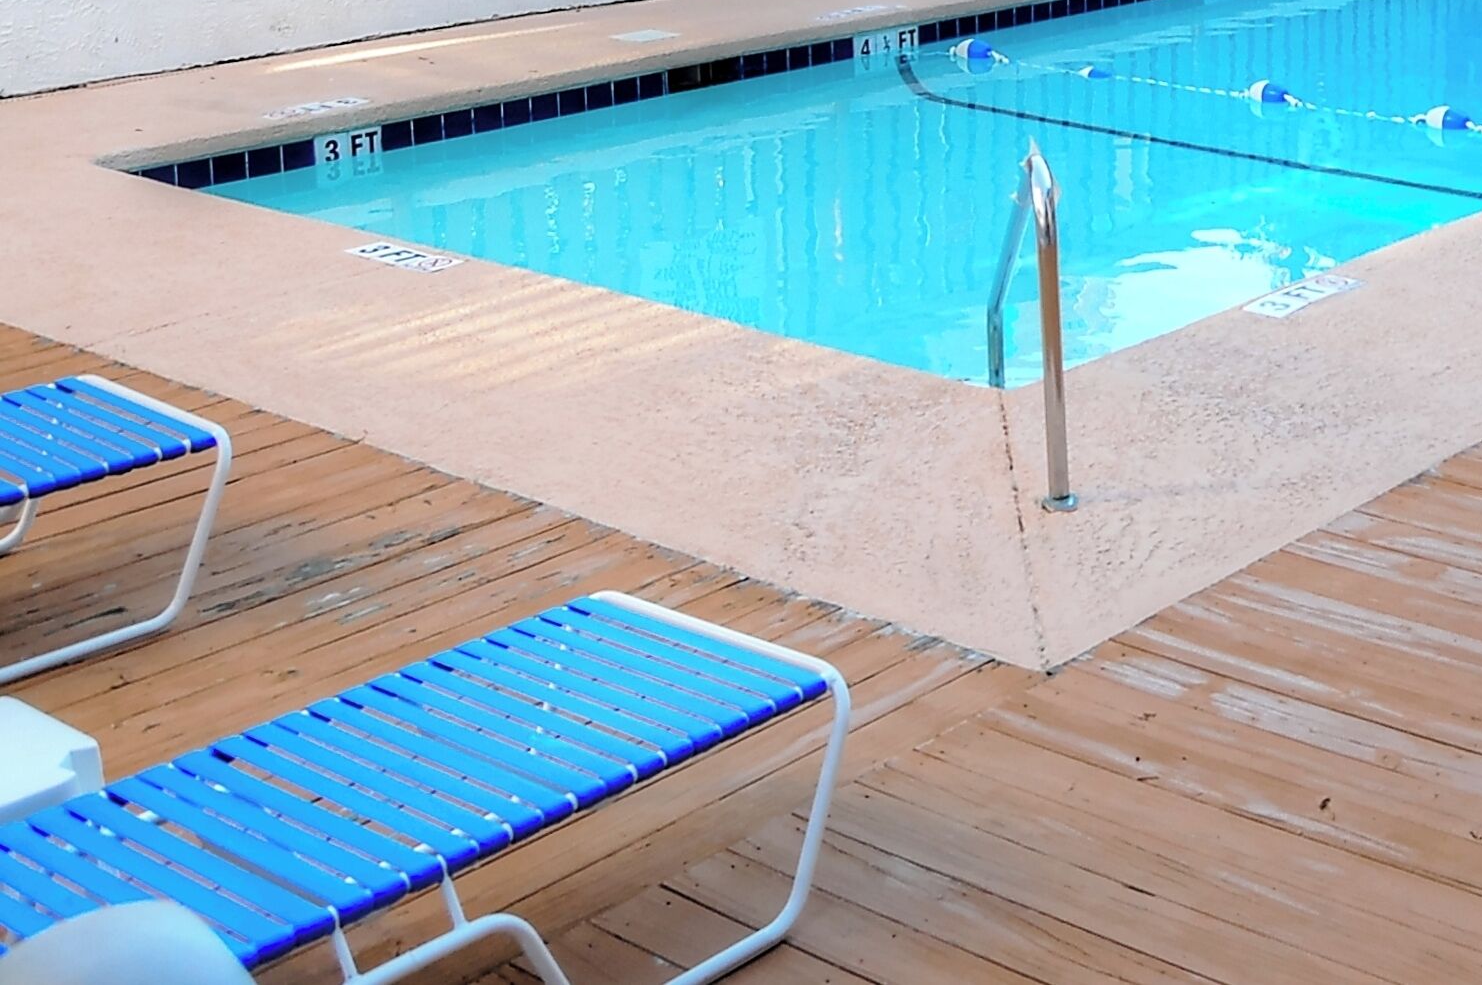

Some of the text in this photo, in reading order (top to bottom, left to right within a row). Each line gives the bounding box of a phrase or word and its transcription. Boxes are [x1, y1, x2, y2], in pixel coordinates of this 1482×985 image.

[861, 39, 870, 55] 4
[899, 29, 916, 50] FT
[324, 131, 378, 162] 3 FT
